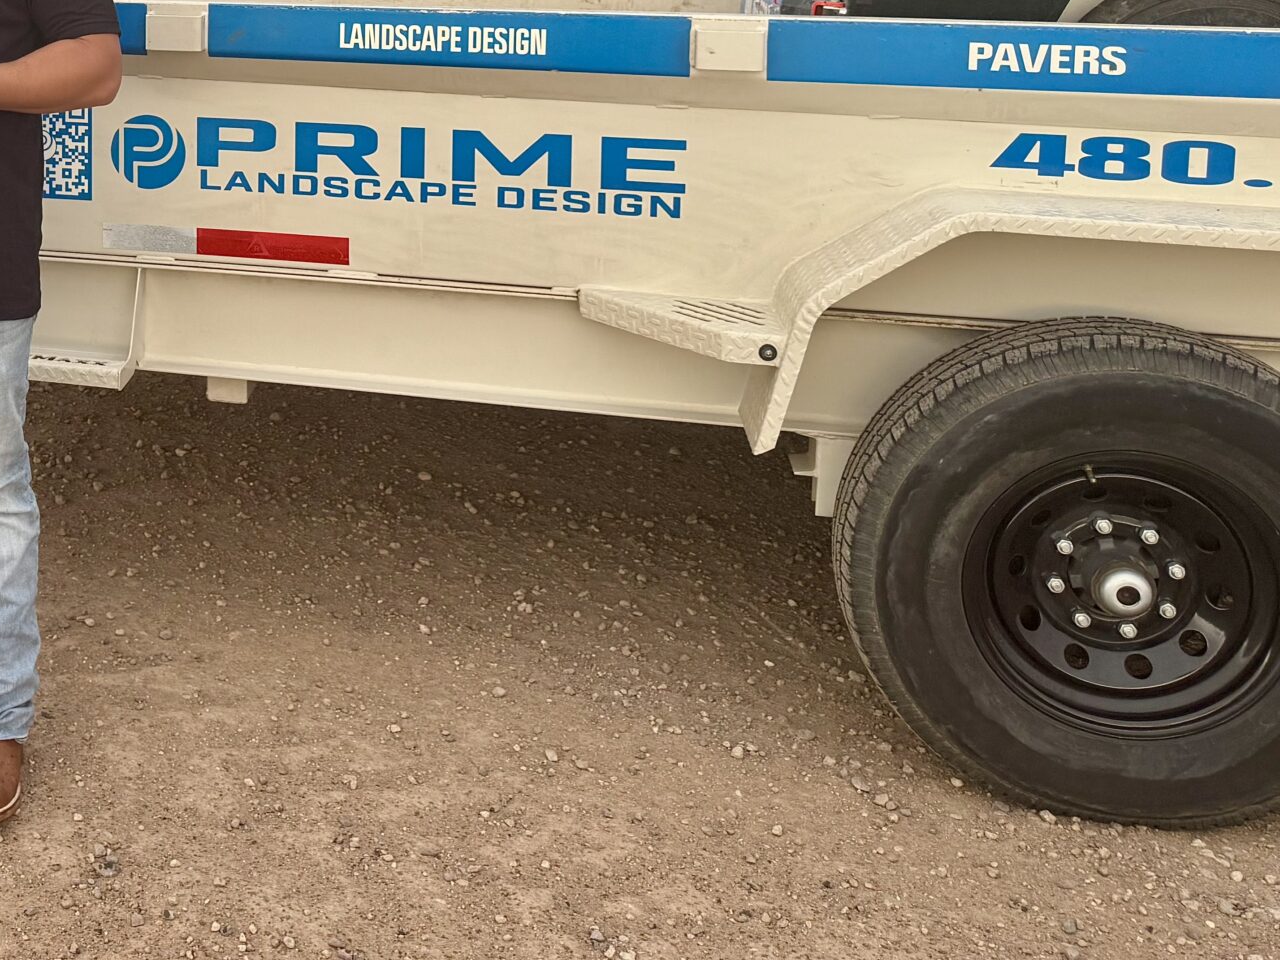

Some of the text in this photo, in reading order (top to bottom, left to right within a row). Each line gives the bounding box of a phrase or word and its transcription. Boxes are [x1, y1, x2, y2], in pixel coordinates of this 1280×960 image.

[339, 22, 547, 56] LANDSCAPE DESIGN
[968, 42, 1127, 76] PAVERS
[197, 117, 687, 194] PRIME
[989, 133, 1273, 188] 480.
[200, 169, 681, 219] LANDSCAPE DESIGN
